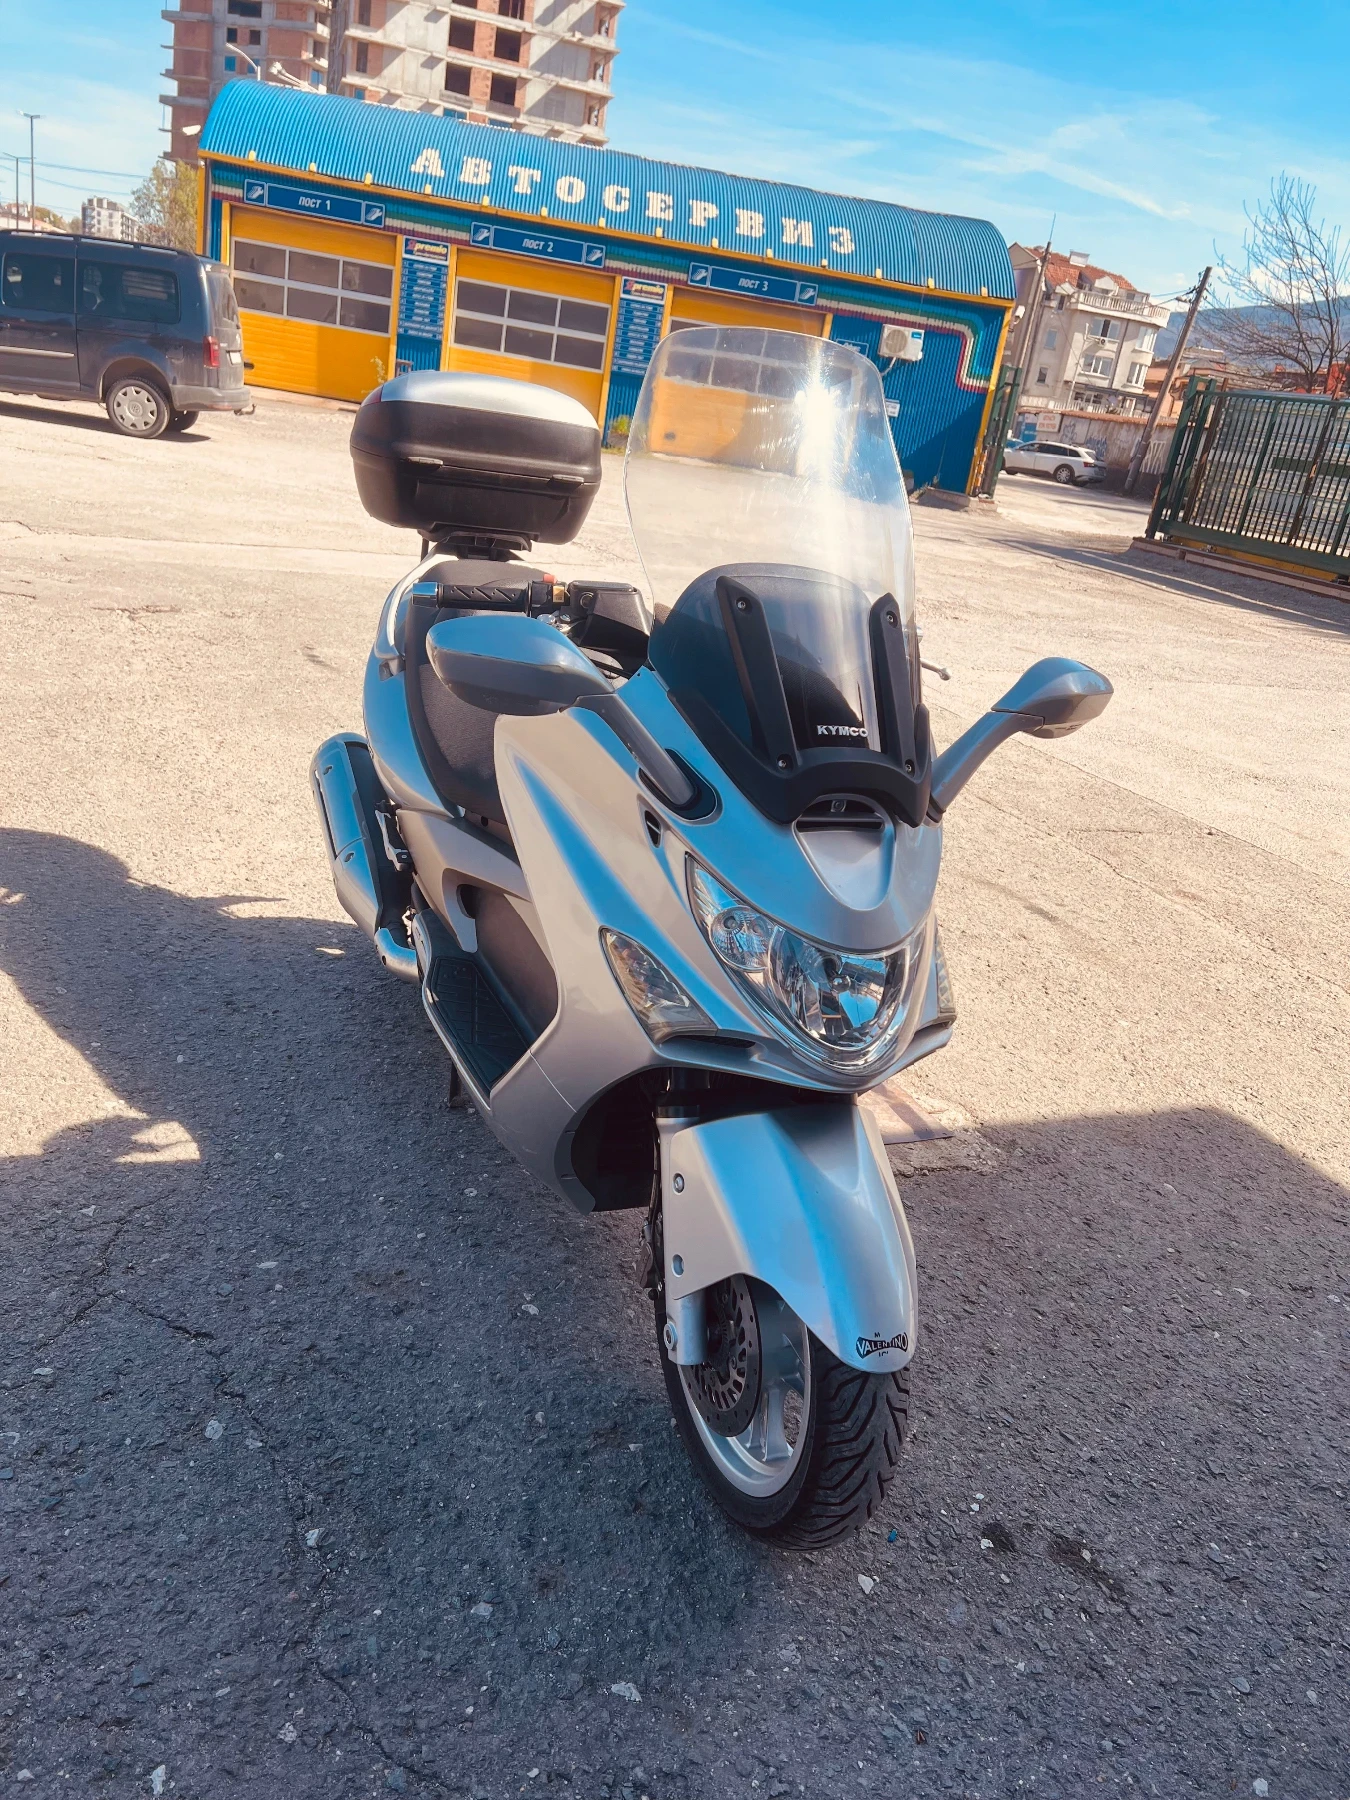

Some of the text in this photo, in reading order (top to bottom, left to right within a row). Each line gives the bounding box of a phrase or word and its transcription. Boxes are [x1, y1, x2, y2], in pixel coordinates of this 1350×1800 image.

[298, 196, 331, 211] ПОСТ 1
[410, 147, 855, 255] АВТОСЕРВИЗ
[522, 238, 554, 253] ПОСТ 2
[738, 277, 769, 292] ПОСТ 3
[817, 725, 868, 737] KYMCO
[856, 1332, 908, 1357] VALENTINO
